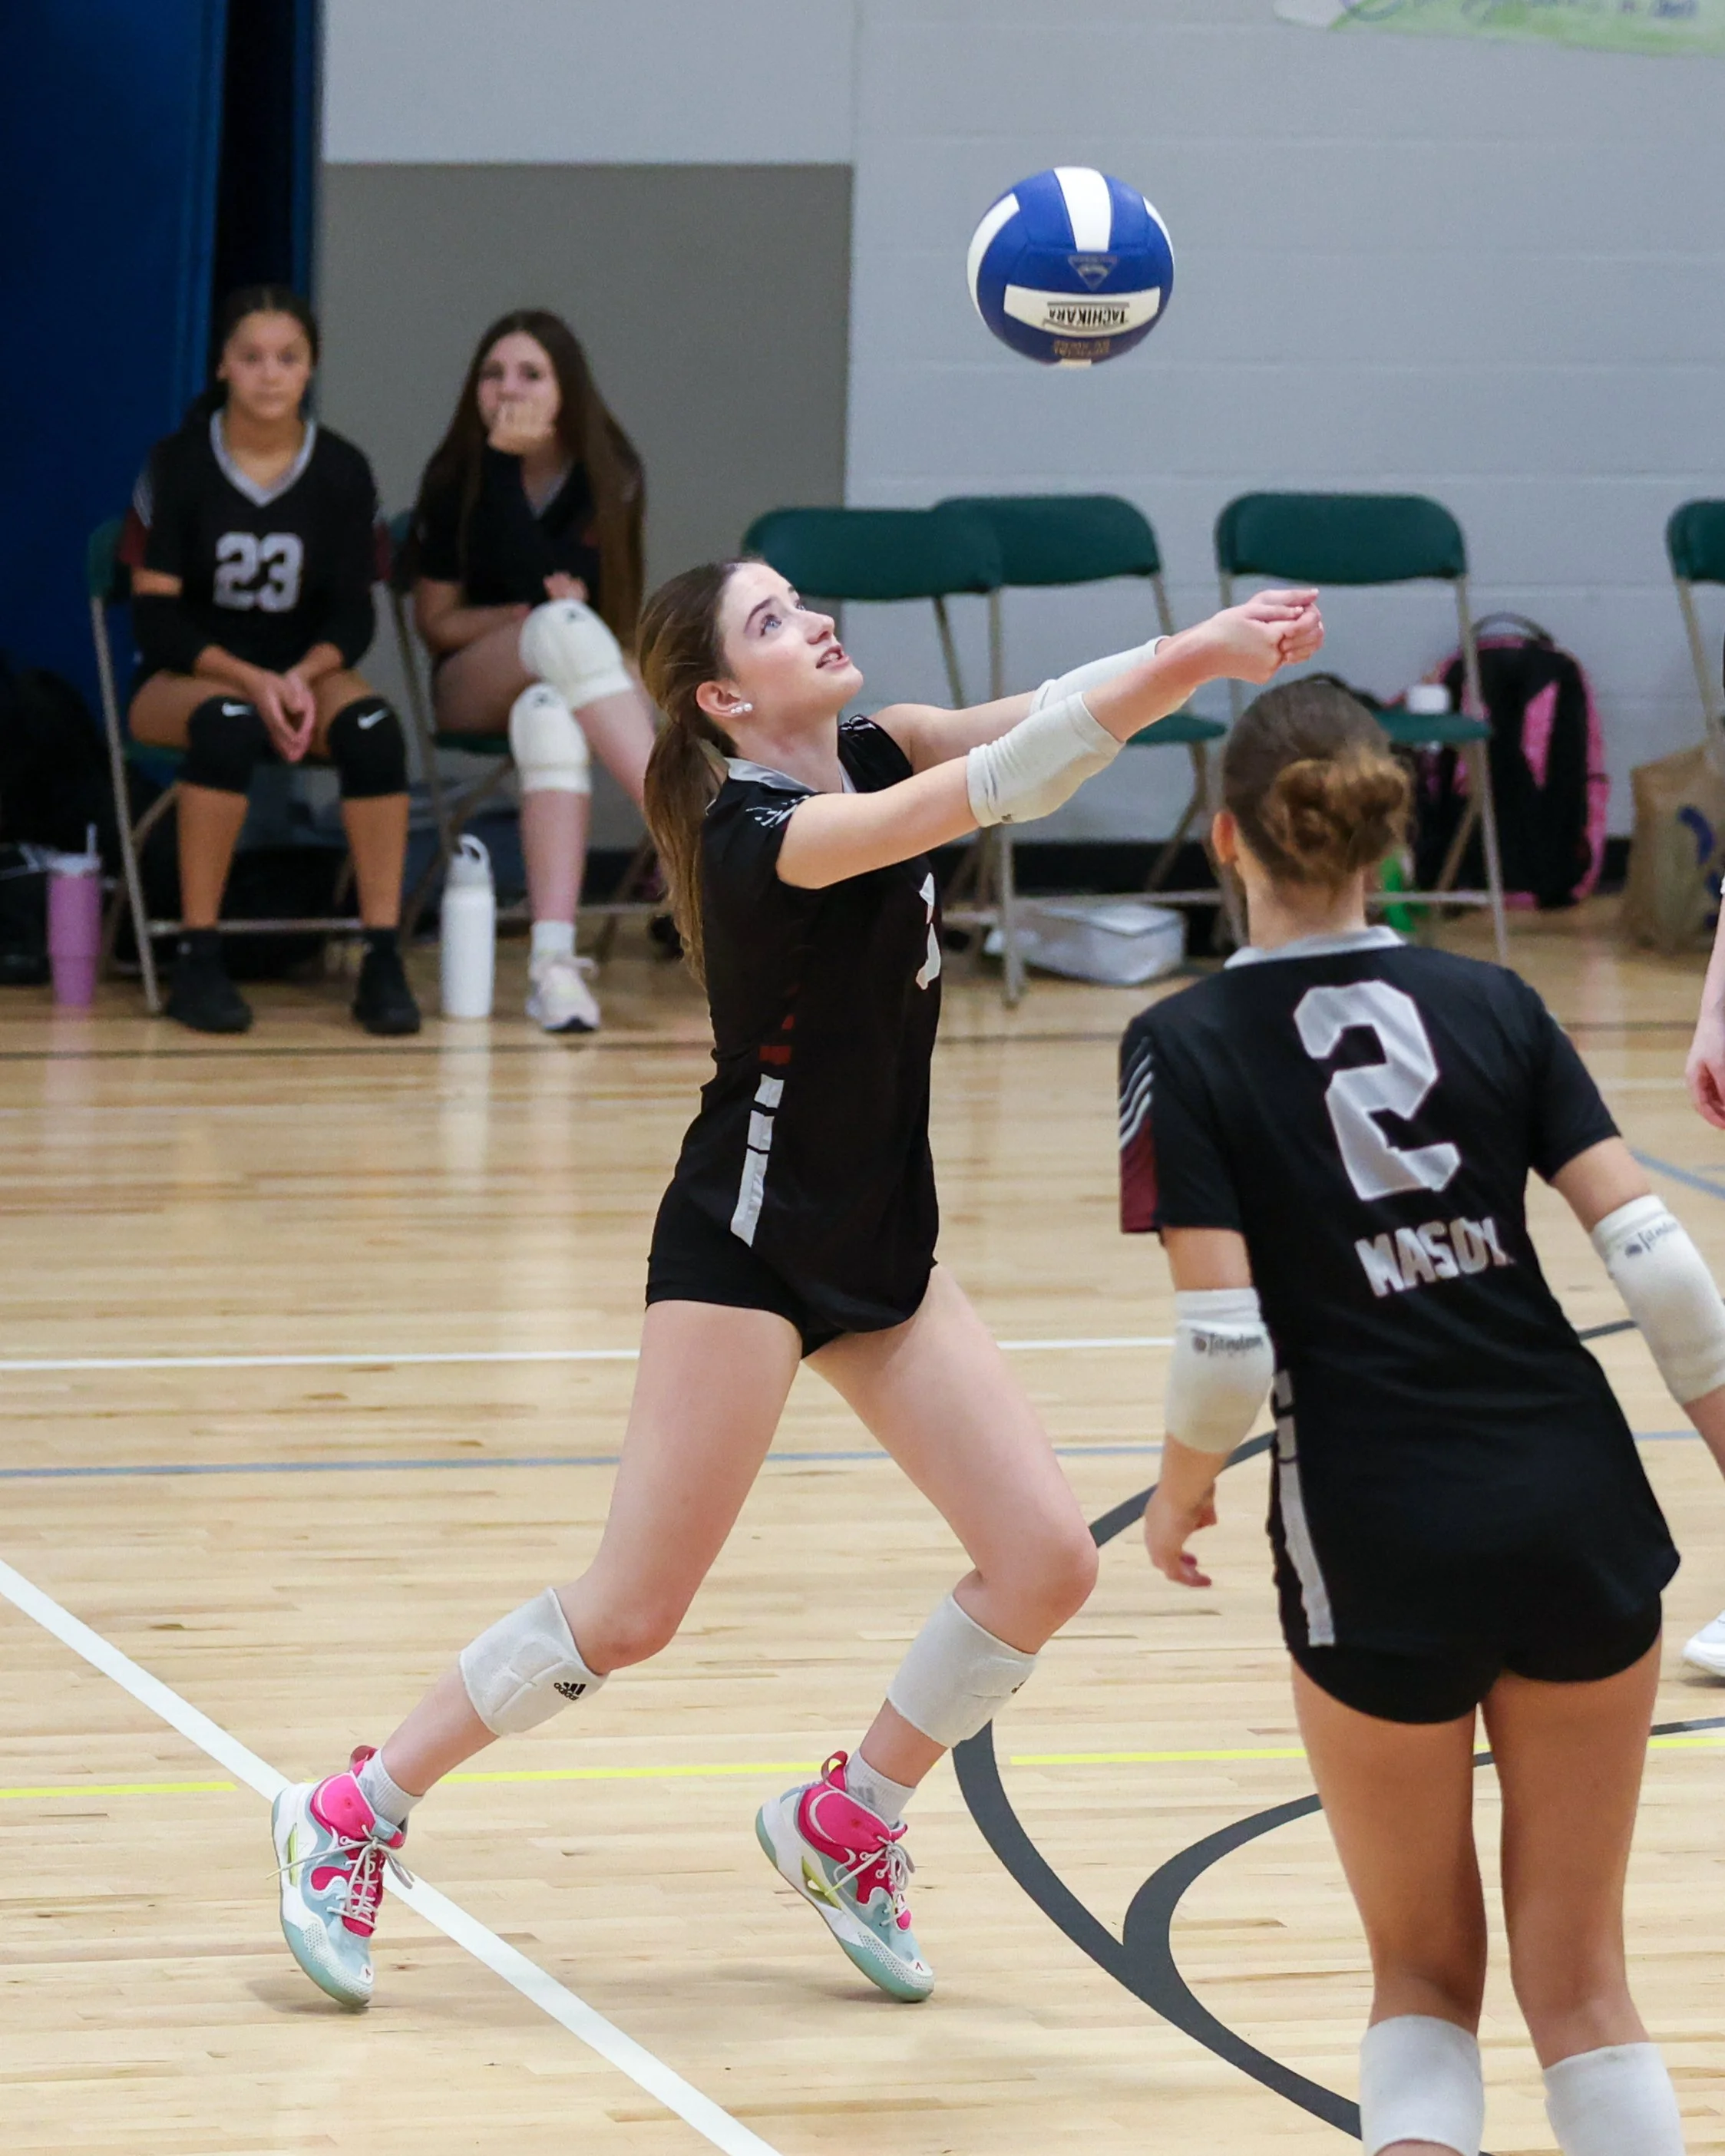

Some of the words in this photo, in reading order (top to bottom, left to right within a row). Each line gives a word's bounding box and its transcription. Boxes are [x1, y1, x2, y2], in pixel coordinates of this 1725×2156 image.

[1048, 308, 1125, 325] TACHIKARA
[213, 531, 303, 612] 23
[1294, 980, 1461, 1202] 2
